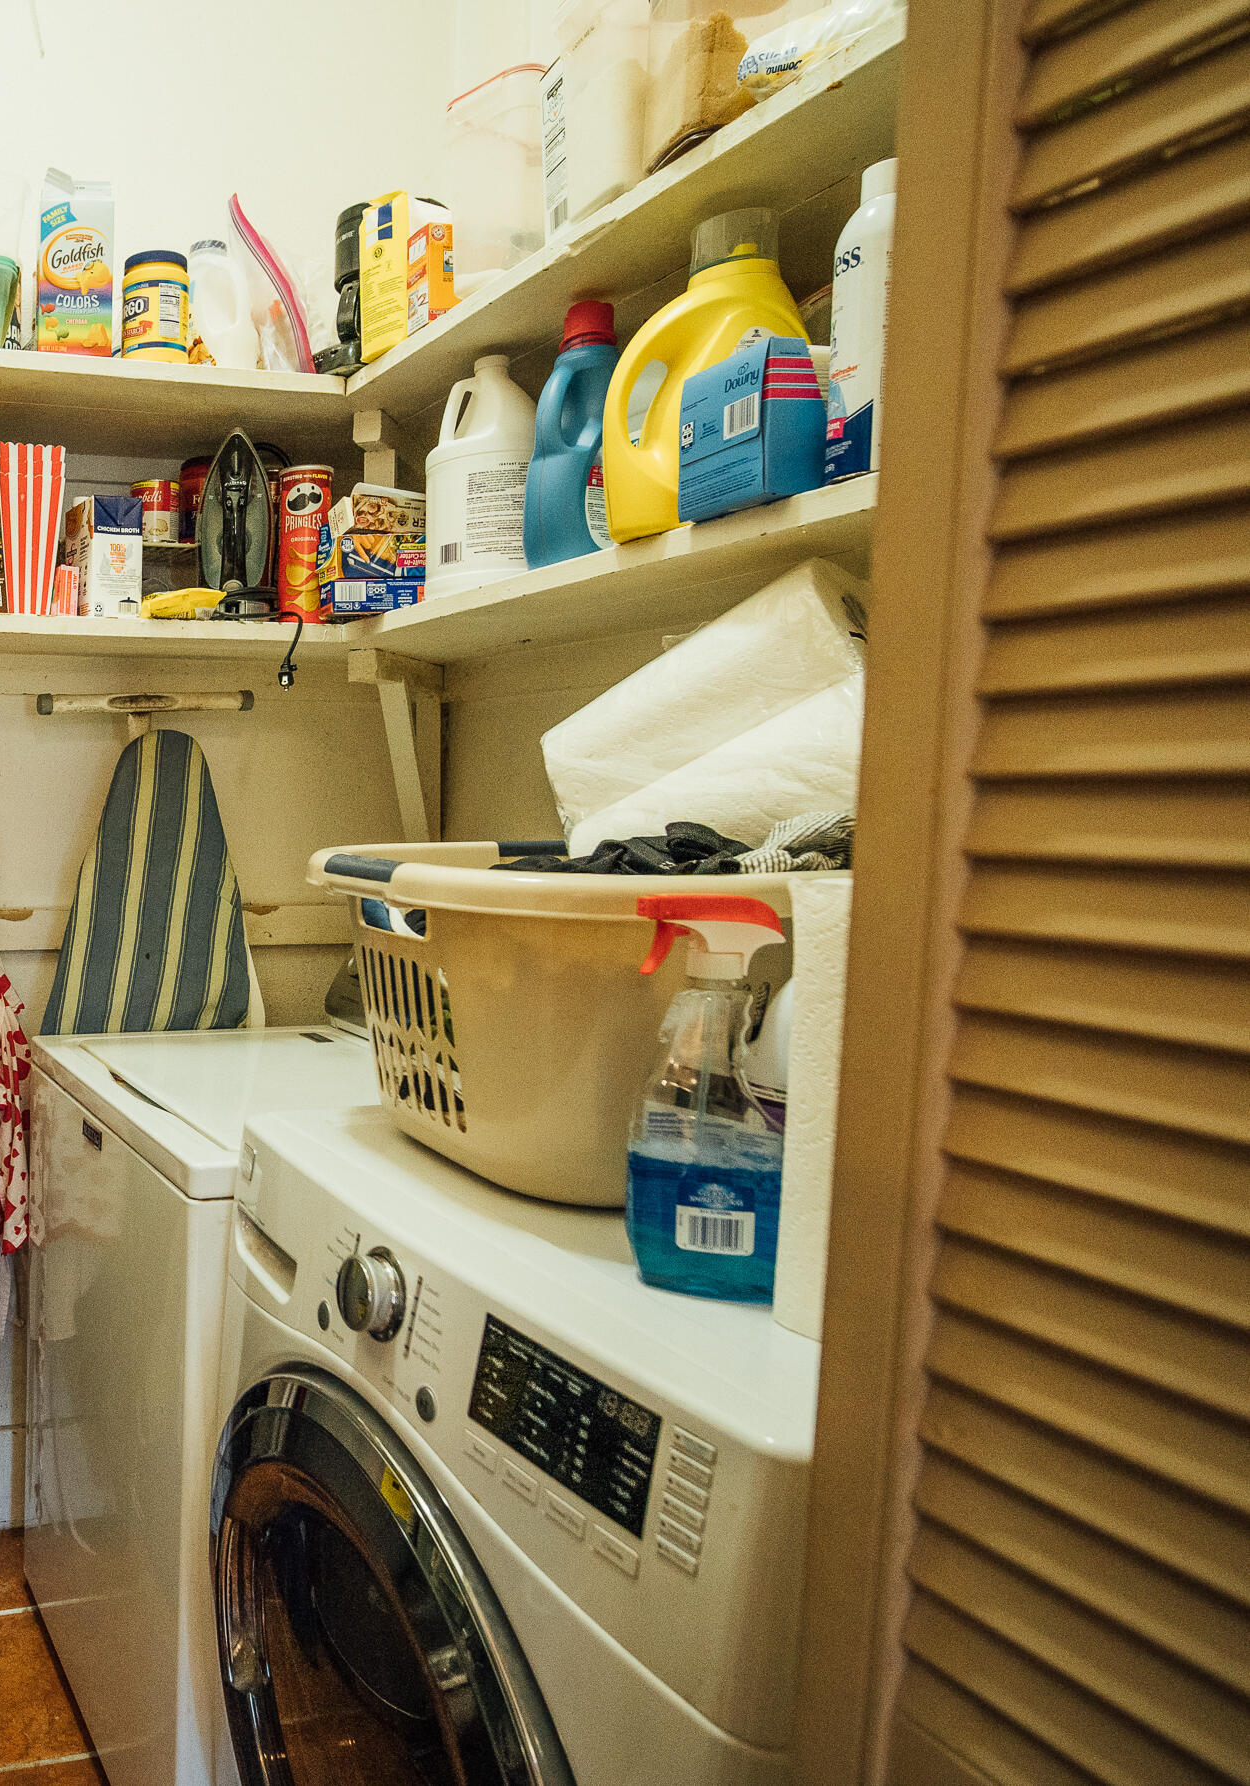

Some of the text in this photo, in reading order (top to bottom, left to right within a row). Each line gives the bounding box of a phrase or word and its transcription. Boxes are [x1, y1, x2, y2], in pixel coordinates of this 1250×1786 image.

[42, 206, 67, 224] FAMILY
[50, 215, 66, 228] SIZE
[51, 243, 104, 269] Goldfish
[835, 246, 861, 277] ess
[56, 294, 100, 309] COLORS
[124, 298, 145, 319] RGO
[725, 367, 760, 393] Downy
[140, 490, 162, 503] bell's
[97, 525, 140, 534] CHICKEN BROTH
[285, 513, 322, 533] PRINGLES
[412, 518, 426, 528] ER
[110, 543, 126, 551] 100%
